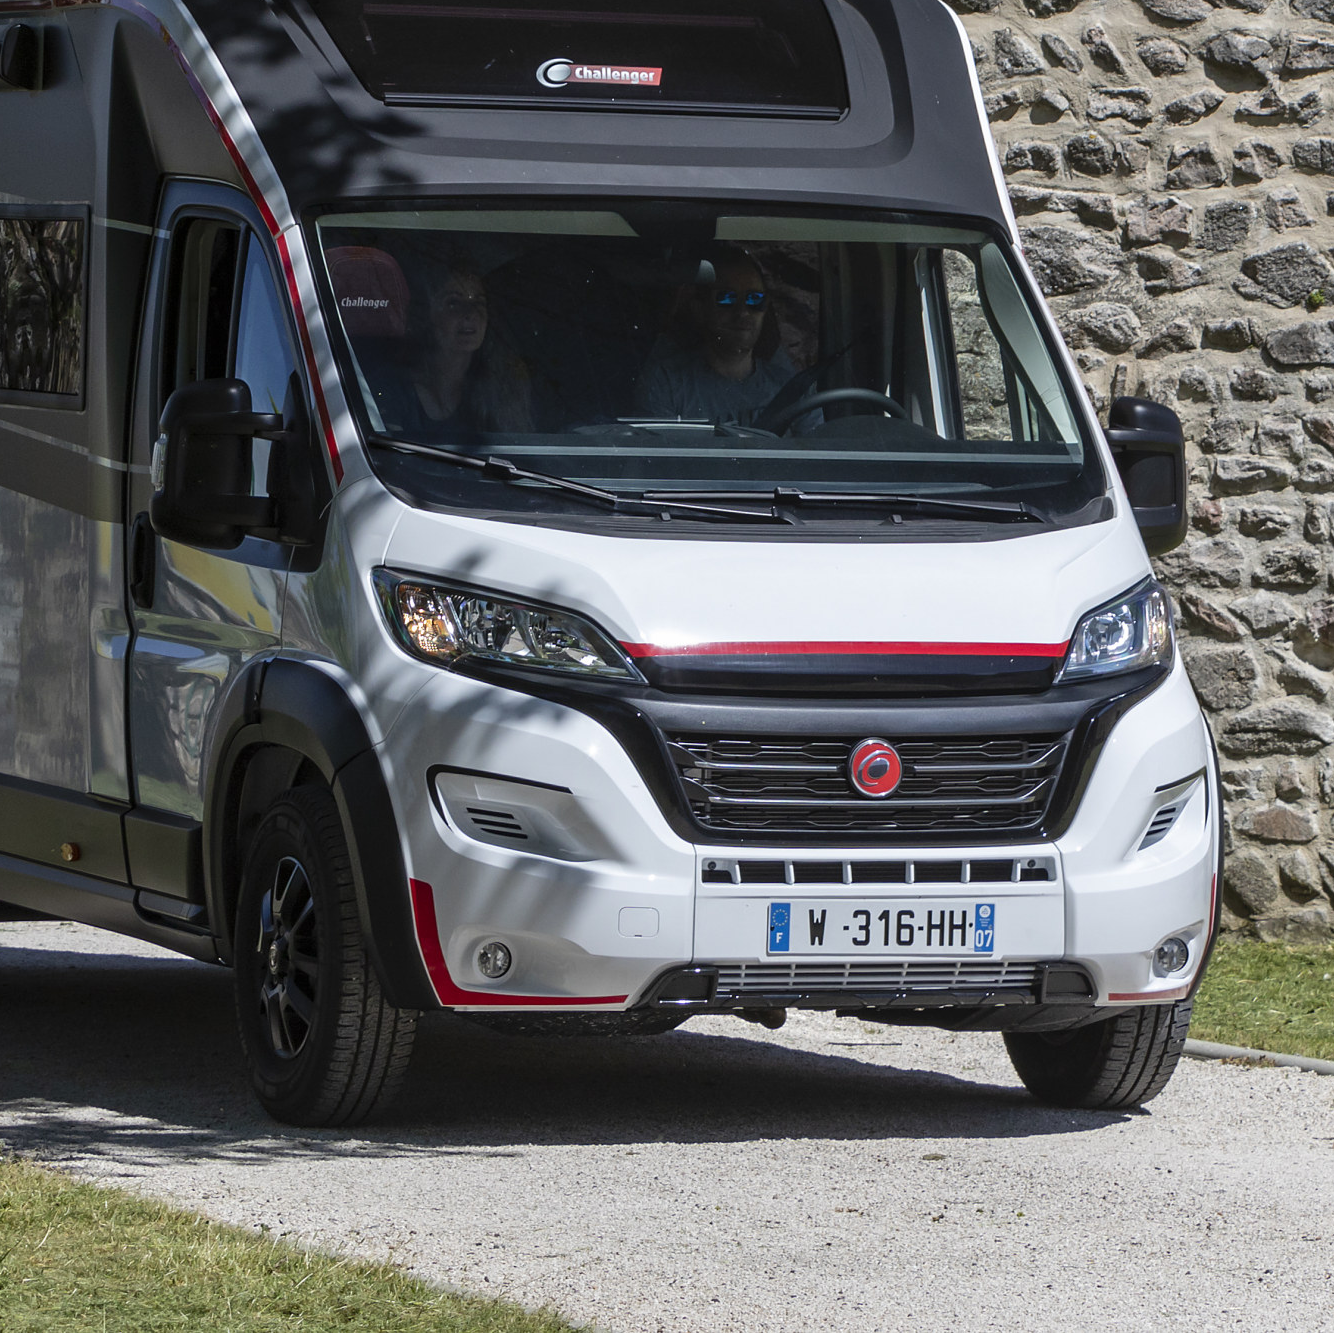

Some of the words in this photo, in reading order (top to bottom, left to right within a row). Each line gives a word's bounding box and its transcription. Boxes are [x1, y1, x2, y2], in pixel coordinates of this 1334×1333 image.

[574, 66, 655, 84] Challenger
[341, 296, 389, 309] Challenger
[776, 932, 784, 944] F
[975, 929, 993, 947] 07
